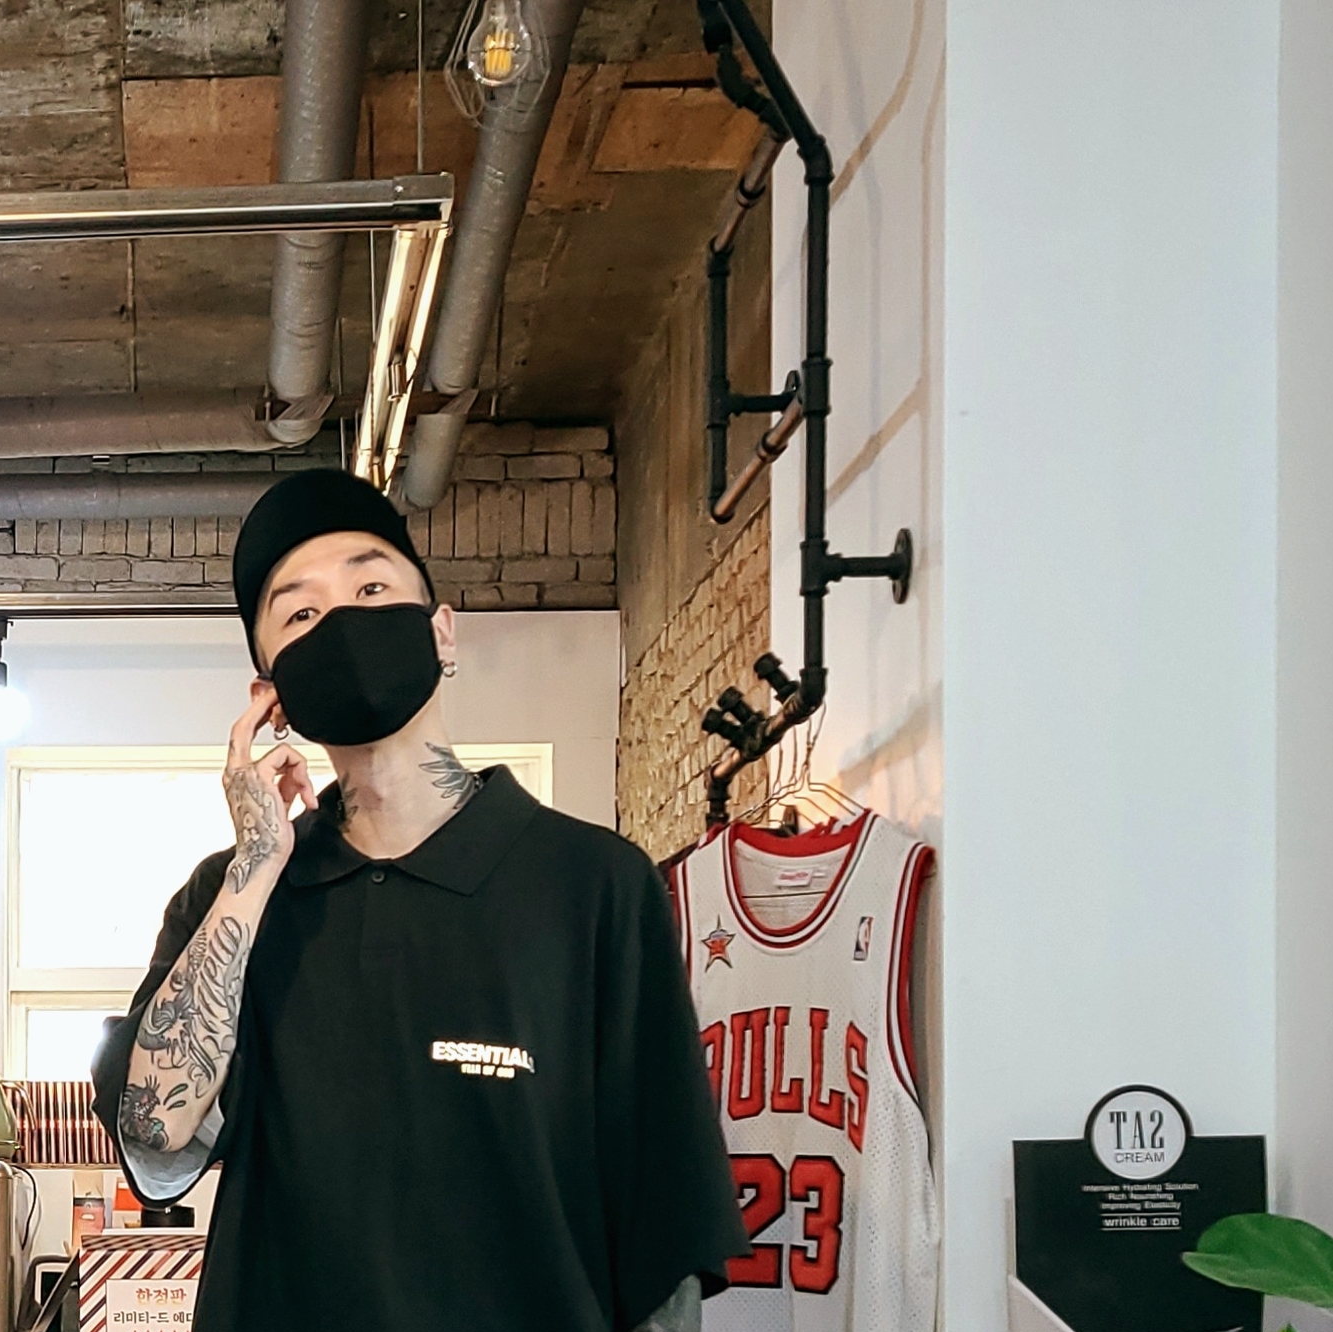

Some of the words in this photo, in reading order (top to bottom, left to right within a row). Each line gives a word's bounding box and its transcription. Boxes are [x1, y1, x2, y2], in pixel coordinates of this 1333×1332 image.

[1115, 1152, 1166, 1164] CREAM
[726, 1153, 845, 1295] 23
[1102, 1217, 1147, 1227] wrinkle
[1151, 1217, 1180, 1227] care
[135, 1287, 187, 1306] 한정판
